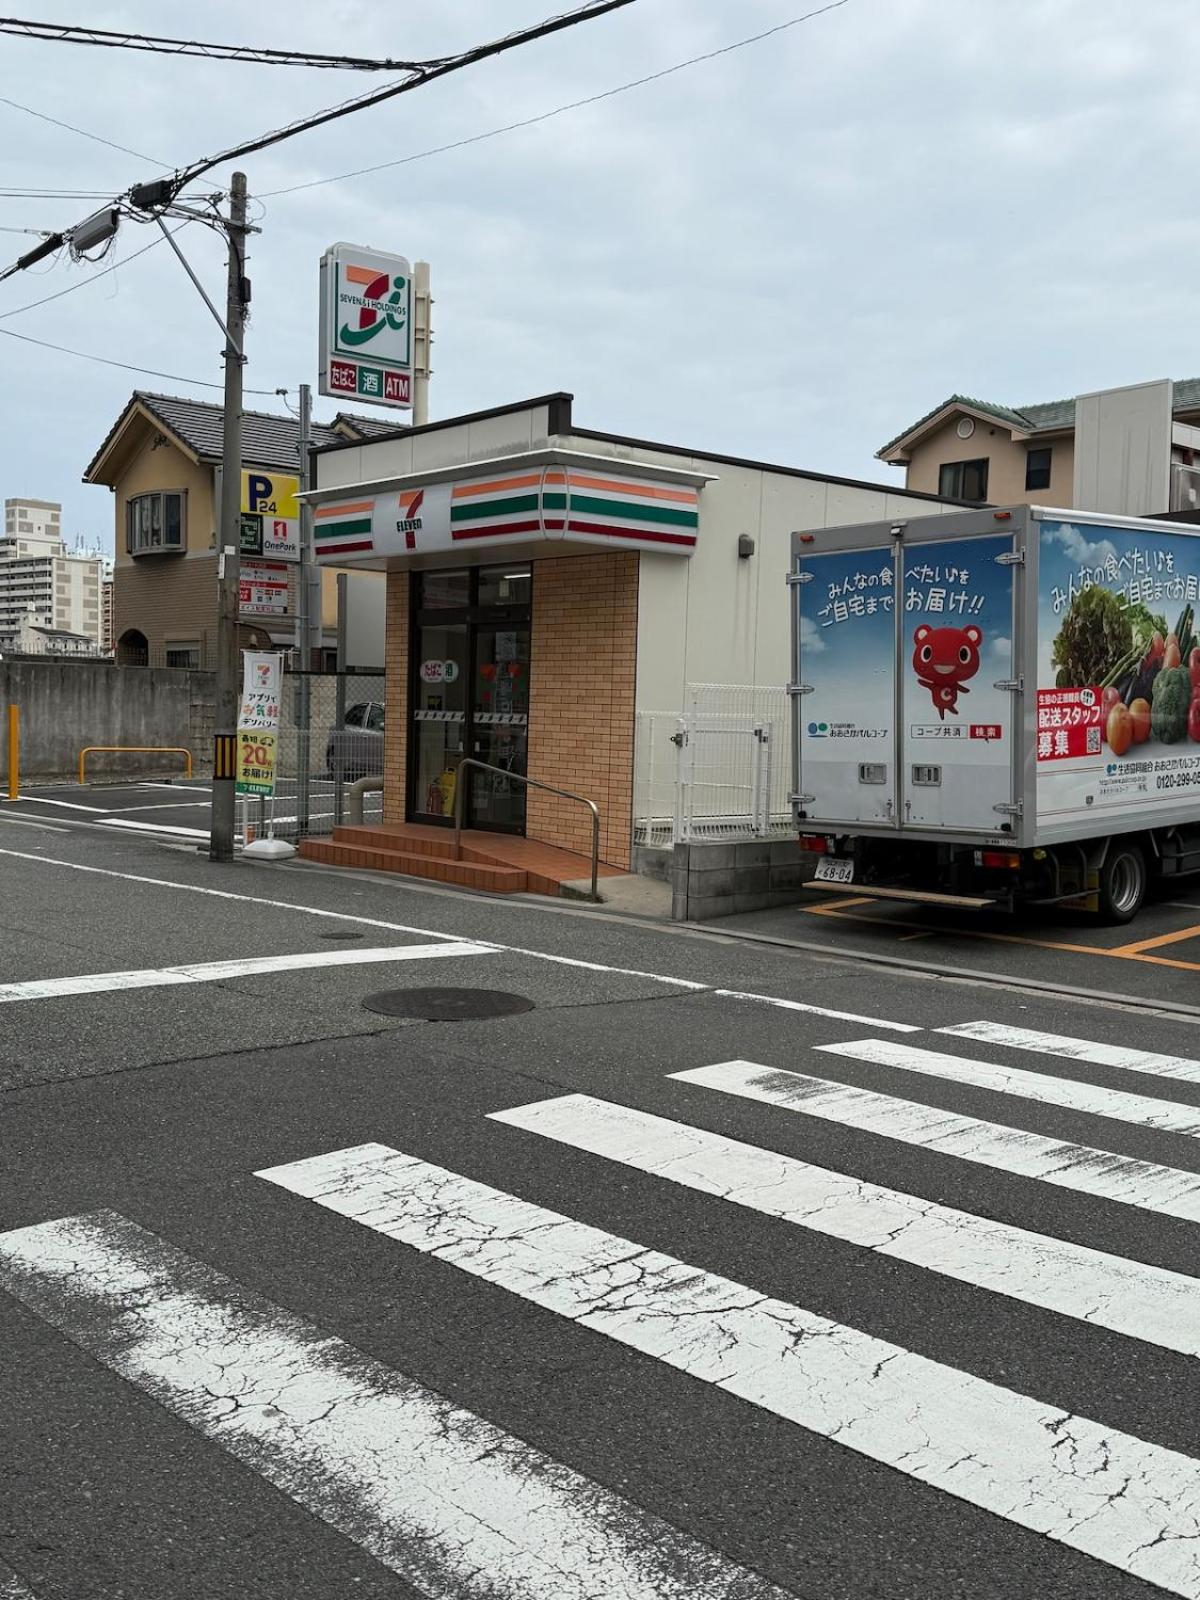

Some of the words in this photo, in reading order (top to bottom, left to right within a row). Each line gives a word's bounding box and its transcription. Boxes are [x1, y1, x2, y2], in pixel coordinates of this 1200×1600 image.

[371, 301, 407, 316] HOLDINGS
[331, 365, 356, 388] たばこ
[363, 371, 379, 392] 酒
[386, 377, 409, 398] ATM
[248, 474, 273, 512] P
[258, 500, 278, 514] 24
[264, 540, 297, 551] OnePark
[1116, 573, 1200, 610] ご自宅までお届
[242, 718, 276, 728] デリバリー
[1038, 705, 1100, 729] 配送スタッフ
[917, 727, 961, 737] コープ共済
[1038, 730, 1069, 758] 募集
